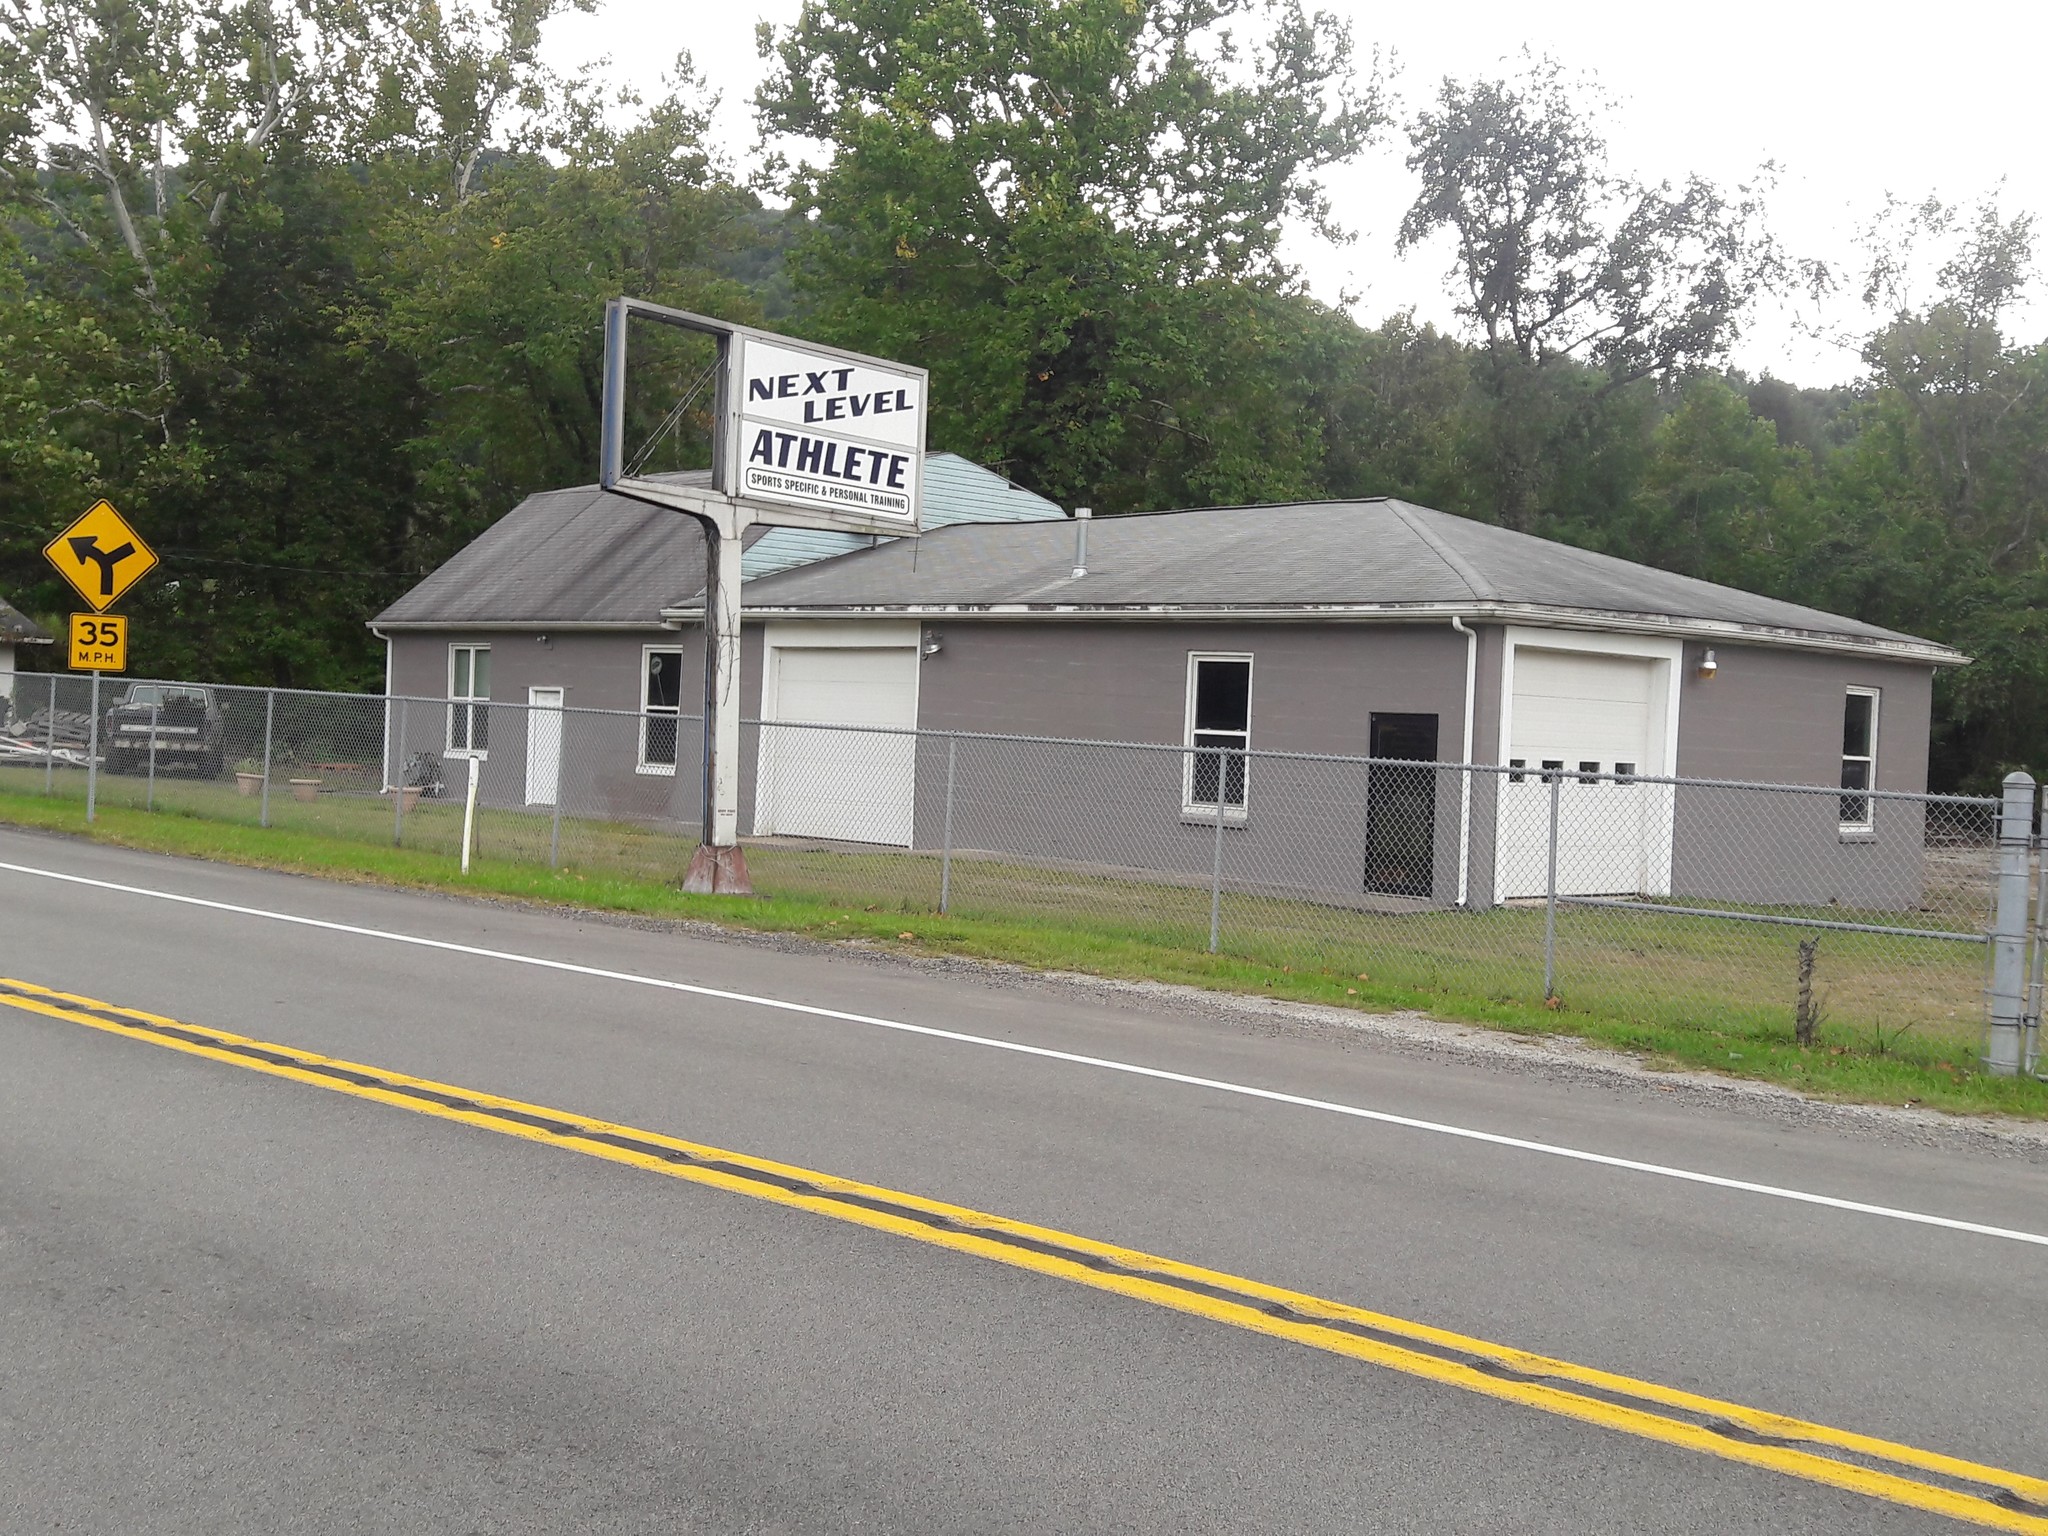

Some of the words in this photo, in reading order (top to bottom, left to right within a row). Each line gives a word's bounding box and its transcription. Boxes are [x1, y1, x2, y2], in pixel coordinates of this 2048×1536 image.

[750, 368, 854, 402] NEXT
[804, 389, 914, 423] LEVEL
[749, 429, 910, 489] ATHLETE
[751, 473, 783, 489] SPORTS
[784, 479, 819, 495] SPECIFIC
[821, 486, 827, 497] &
[829, 487, 868, 504] PERSONAL
[870, 494, 905, 509] TRAINING
[78, 621, 119, 647] 35
[78, 651, 116, 664] M.P.H.
